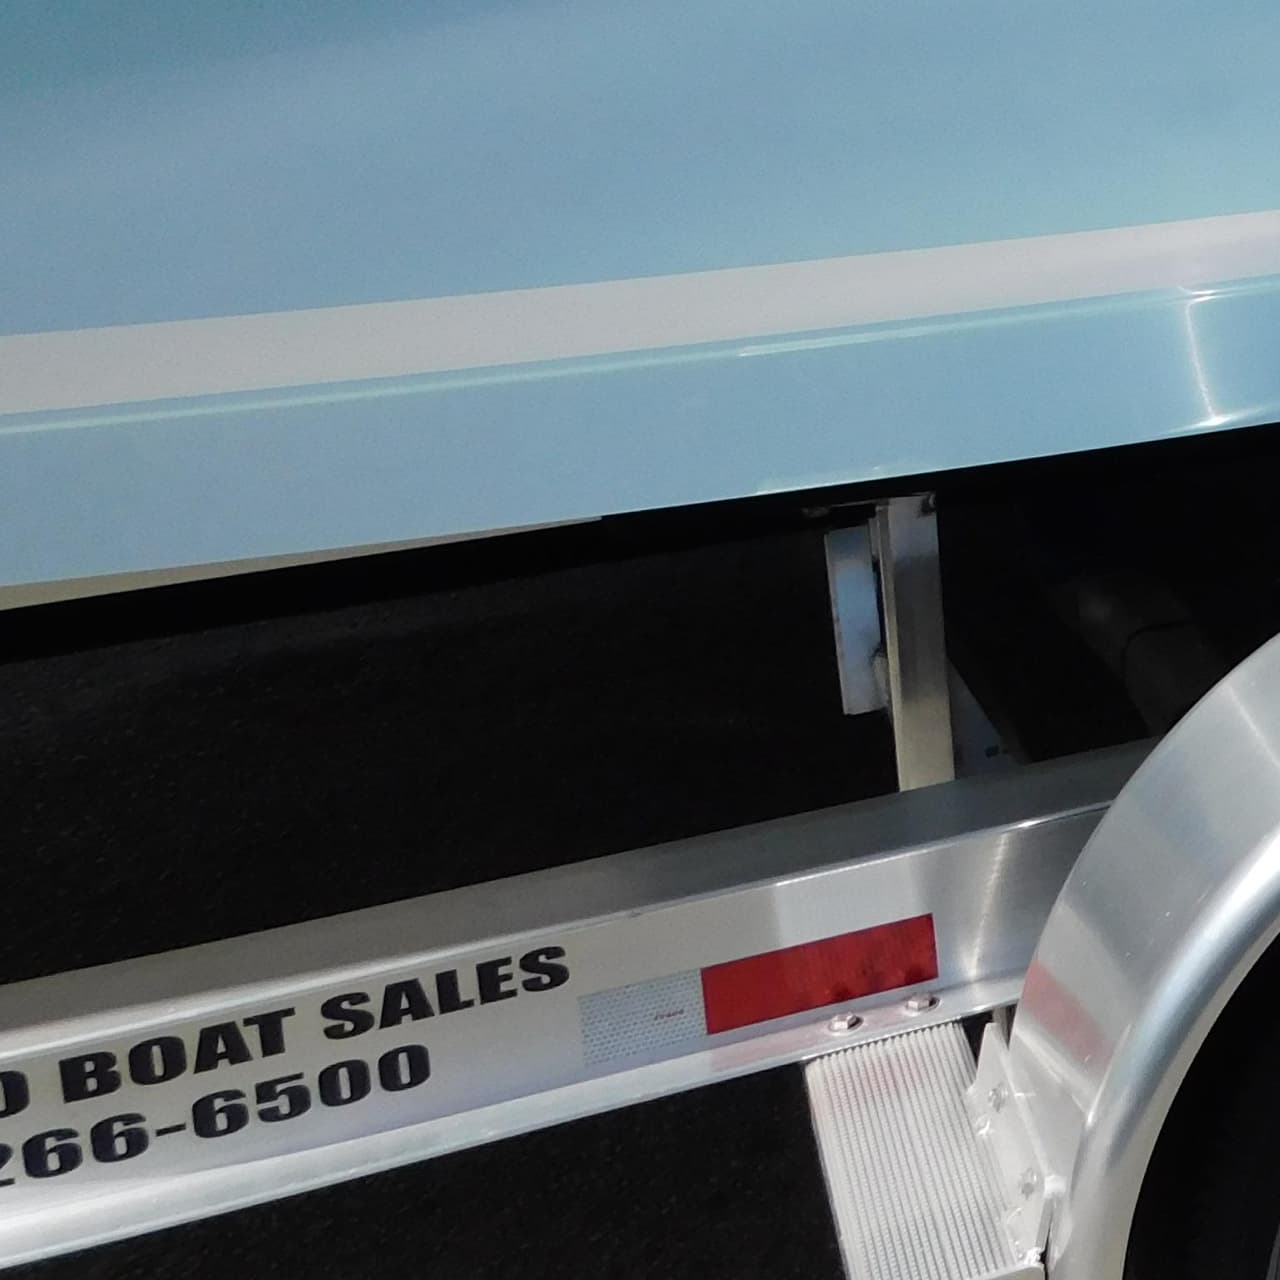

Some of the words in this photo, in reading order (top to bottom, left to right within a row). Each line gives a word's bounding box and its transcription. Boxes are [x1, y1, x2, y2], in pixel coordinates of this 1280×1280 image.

[58, 1008, 297, 1105] BOAT
[319, 945, 572, 1041] SALES
[0, 1042, 432, 1188] 66-6500
